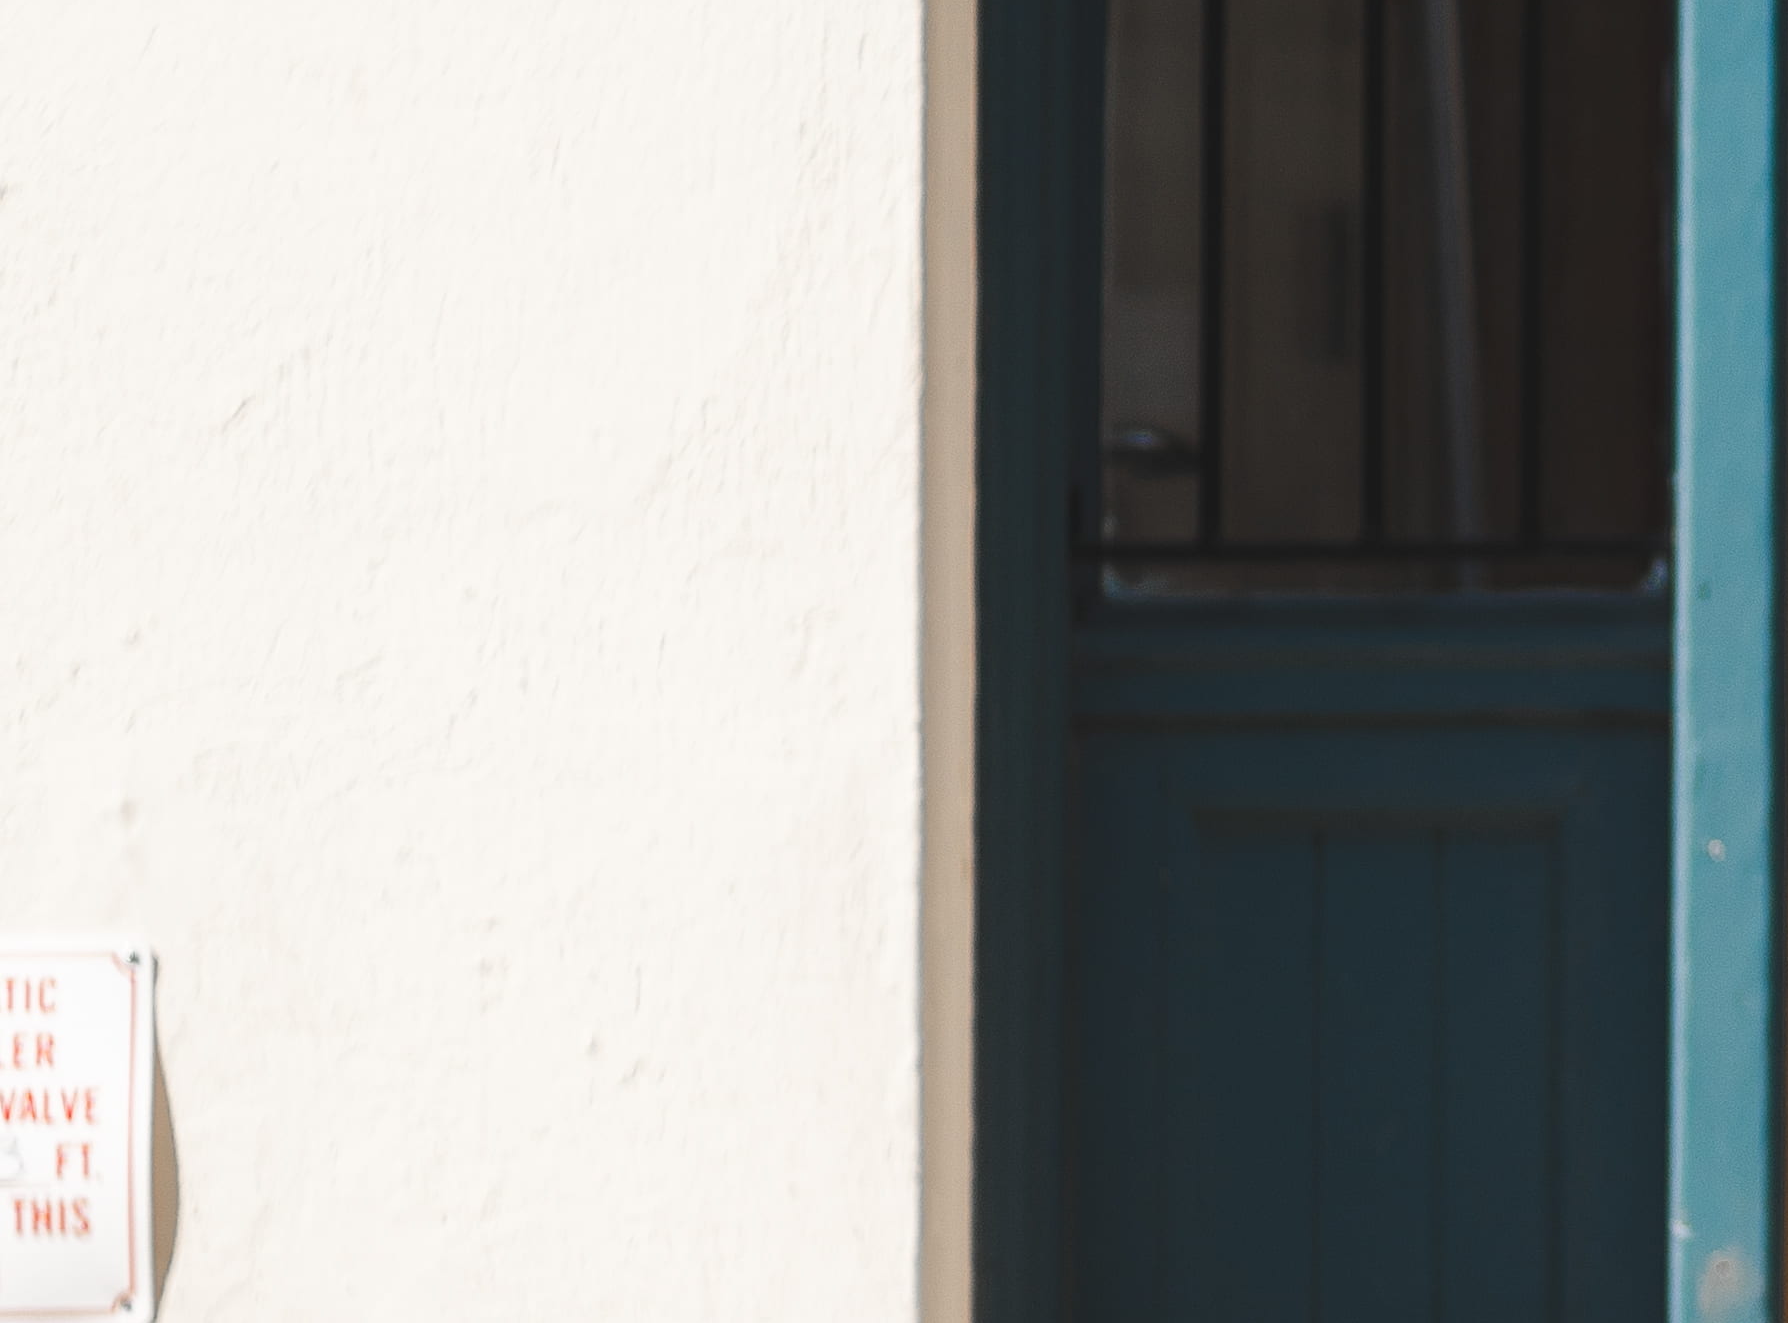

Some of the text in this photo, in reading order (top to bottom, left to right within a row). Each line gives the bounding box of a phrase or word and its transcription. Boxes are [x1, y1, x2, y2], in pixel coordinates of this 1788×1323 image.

[0, 976, 57, 1013] TIC
[0, 1031, 54, 1071] ER
[0, 1086, 98, 1123] VALVE
[12, 1195, 91, 1237] THIS
